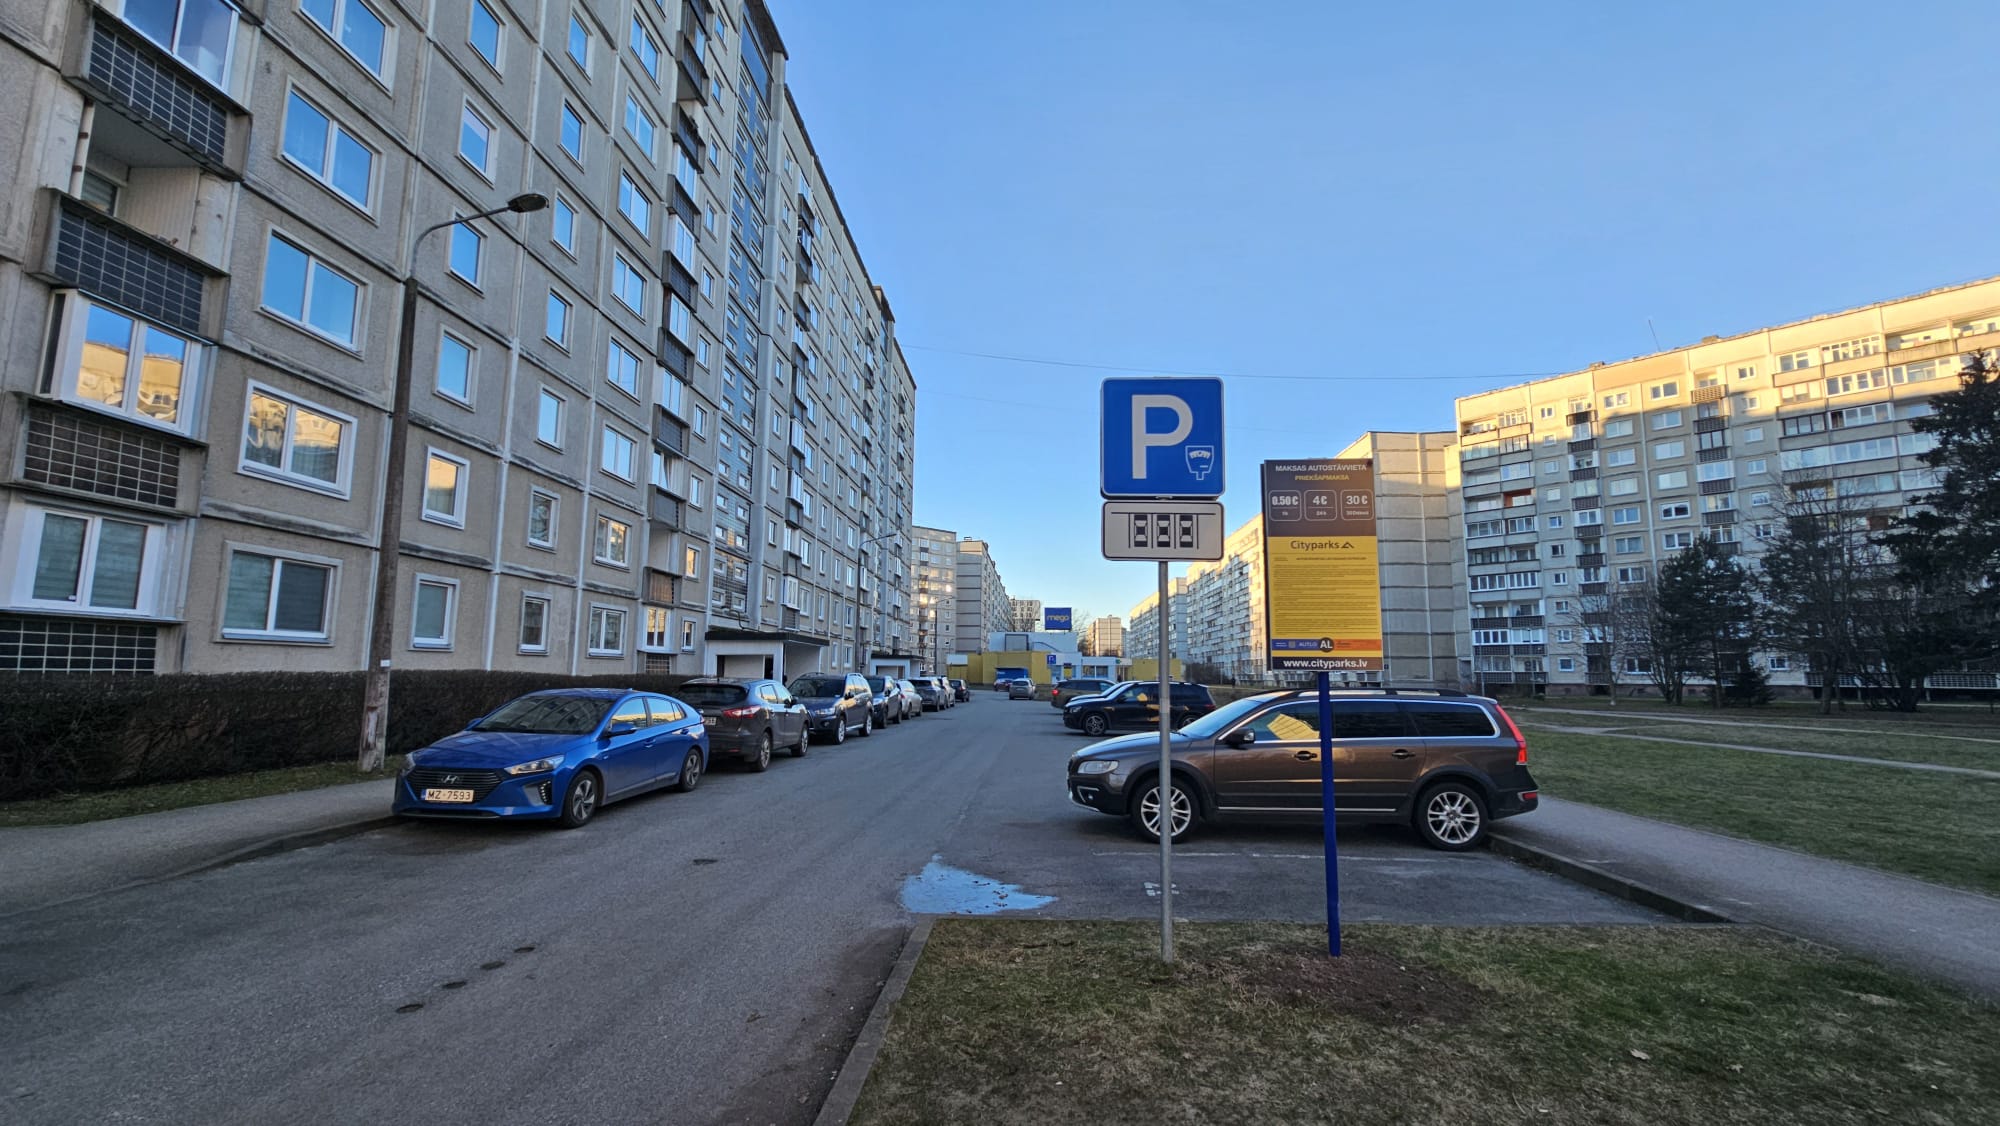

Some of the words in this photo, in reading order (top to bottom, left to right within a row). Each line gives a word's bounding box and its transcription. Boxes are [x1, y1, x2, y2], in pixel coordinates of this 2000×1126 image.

[1131, 394, 1194, 480] P
[1290, 540, 1340, 551] Cityparks
[1320, 640, 1333, 649] AL
[1283, 659, 1368, 670] www.cityparks.lv
